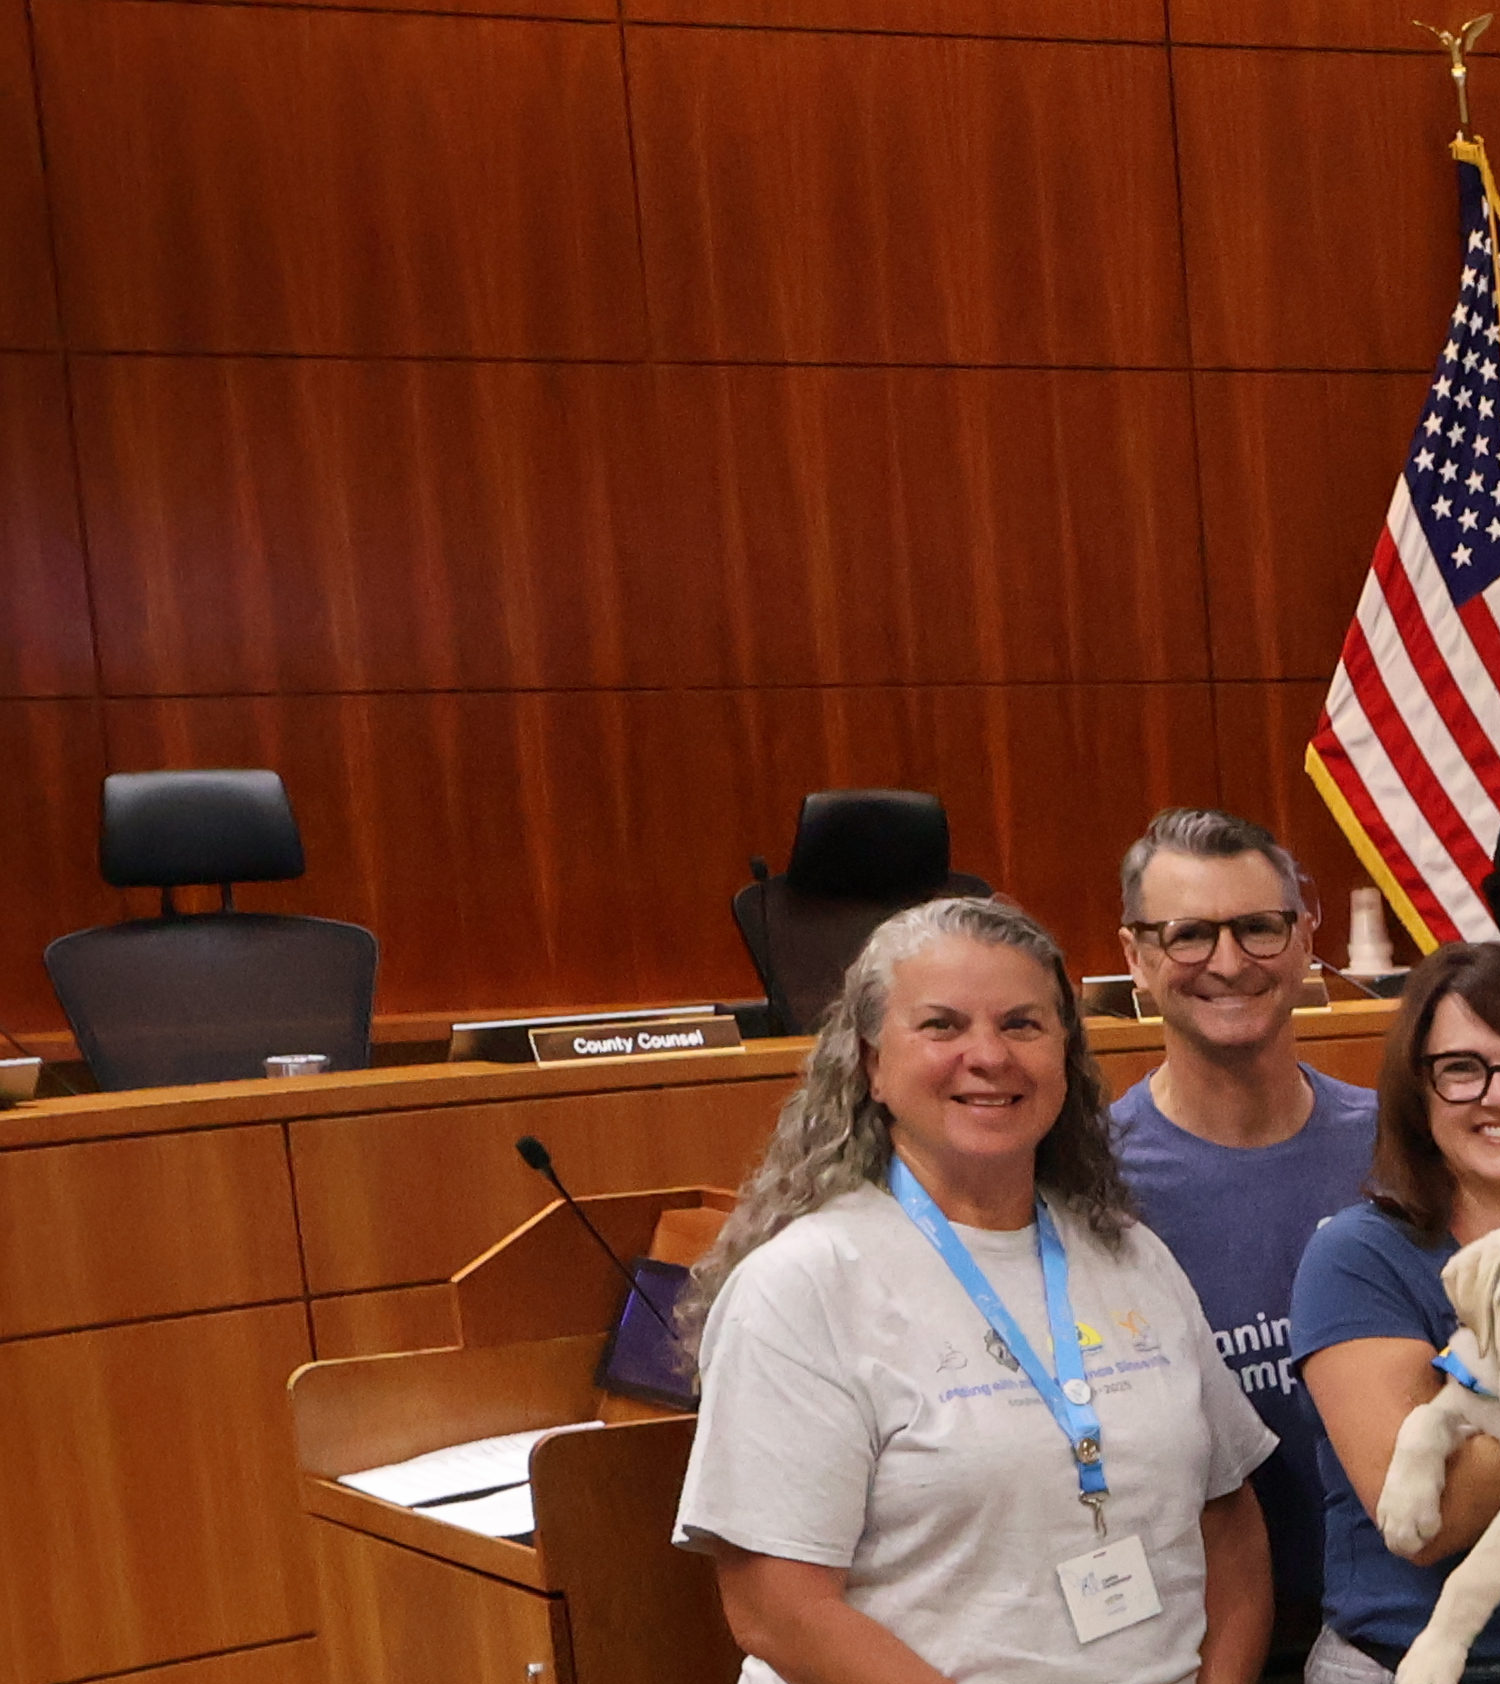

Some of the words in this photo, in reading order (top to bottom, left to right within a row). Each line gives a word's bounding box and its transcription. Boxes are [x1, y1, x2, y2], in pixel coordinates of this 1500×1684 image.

[573, 1036, 634, 1054] County
[637, 1028, 704, 1050] Counsel
[1213, 1311, 1292, 1357] anin
